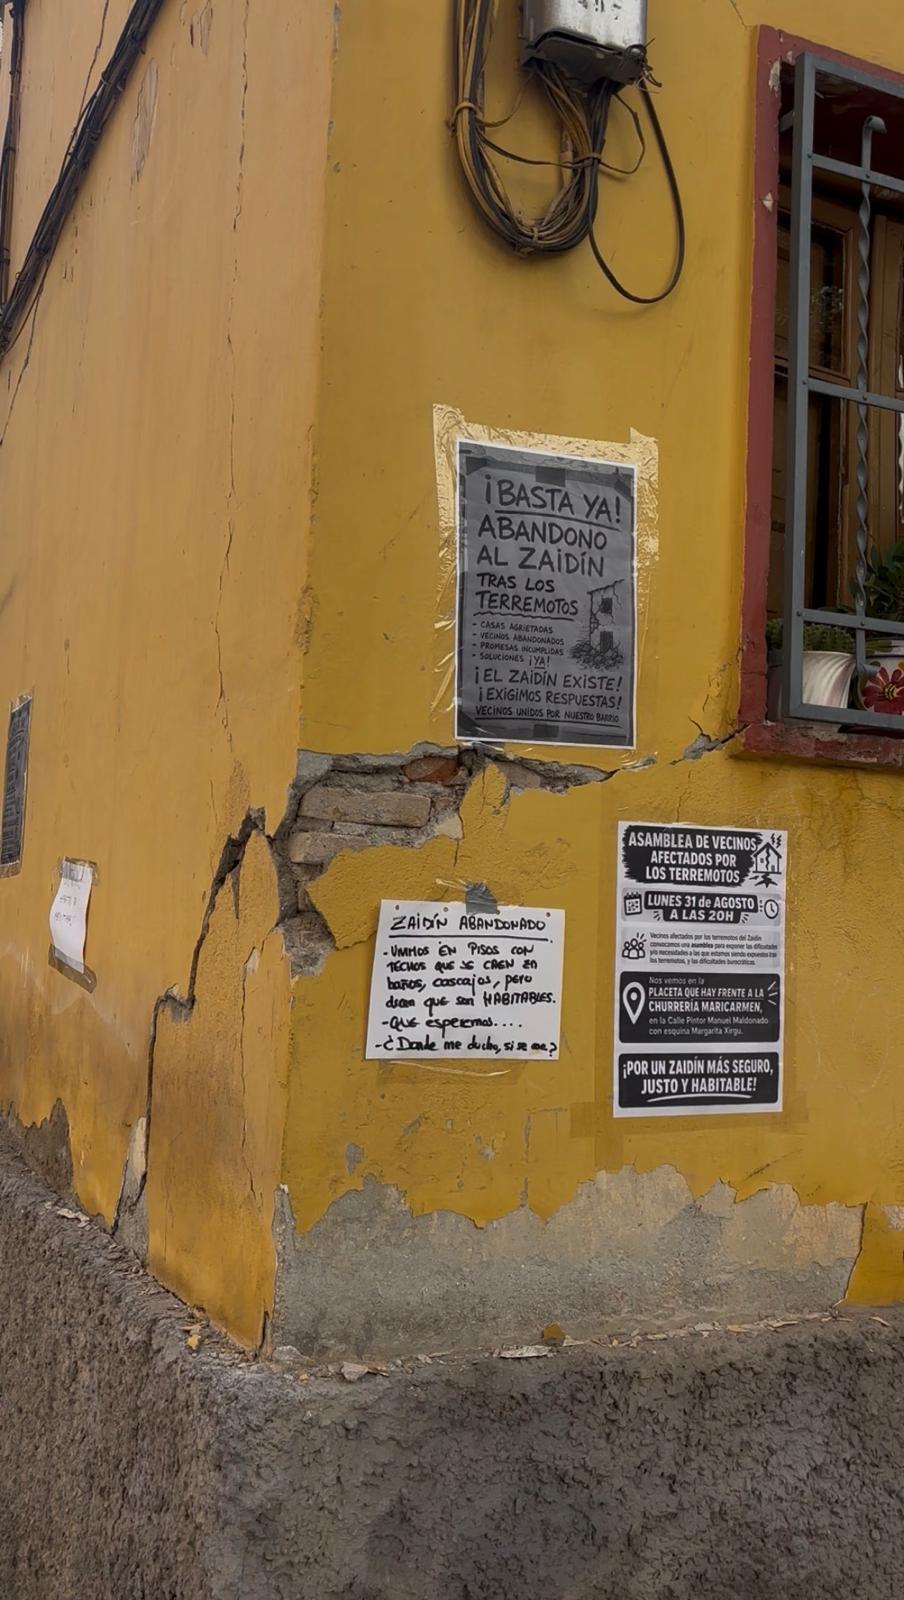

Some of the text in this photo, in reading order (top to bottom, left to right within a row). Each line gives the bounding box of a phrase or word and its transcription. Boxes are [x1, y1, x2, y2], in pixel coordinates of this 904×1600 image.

[485, 474, 620, 524] ¡BASTA YA!
[478, 514, 607, 550] ABANDONO
[477, 545, 508, 566] AL
[476, 572, 555, 592] TRAS LOS
[476, 590, 578, 616] TERREMOTOS
[480, 621, 506, 630] CASAS
[510, 623, 554, 634] AGRIETADAS
[480, 632, 509, 640] VECINOS
[513, 634, 564, 646] ABANDONADOS
[480, 642, 518, 652] PROMESAS
[522, 646, 564, 656] INCUMPLIDAS
[480, 652, 524, 662] SOLUCIONES
[528, 656, 550, 667] ¡YA!
[475, 666, 502, 684] ¡EL
[563, 675, 622, 692] EXISTE!
[479, 686, 622, 710] ¡EXIGIMOS RESPUESTAS!
[476, 704, 619, 723] VECINOS UNIDOS POR NUESTRO BARRIO
[628, 832, 756, 851] ASAMBLEA DE VECINOS
[650, 850, 736, 867] AFECTADOS POR
[646, 866, 740, 882] LOS TERREMOTOS
[648, 894, 755, 910] LUNES 31 de AGOSTO
[459, 915, 546, 931] ABANDONADO
[670, 910, 734, 922] A LAS 20H
[670, 932, 693, 940] afectados
[468, 942, 500, 956] PISOS
[510, 944, 534, 955] CON
[483, 958, 514, 970] CAEN
[649, 976, 662, 984] Nos
[648, 987, 764, 998] PLACETA QUE HAY FRENTE A LA
[648, 999, 762, 1014] CHURRERÍA MARICARMEN,
[667, 1016, 684, 1024] Calle
[686, 1016, 706, 1024] Pintor
[708, 1016, 732, 1024] Manuel
[732, 1016, 768, 1024] Maldonado
[664, 1028, 690, 1036] esquina
[691, 1027, 722, 1036] Margarita
[724, 1027, 744, 1036] Xirgu.
[623, 1056, 774, 1079] ¡POR UN ZAIDÍN MÁS SEGURO,
[641, 1077, 757, 1094] JUSTO Y HABITABLE!
